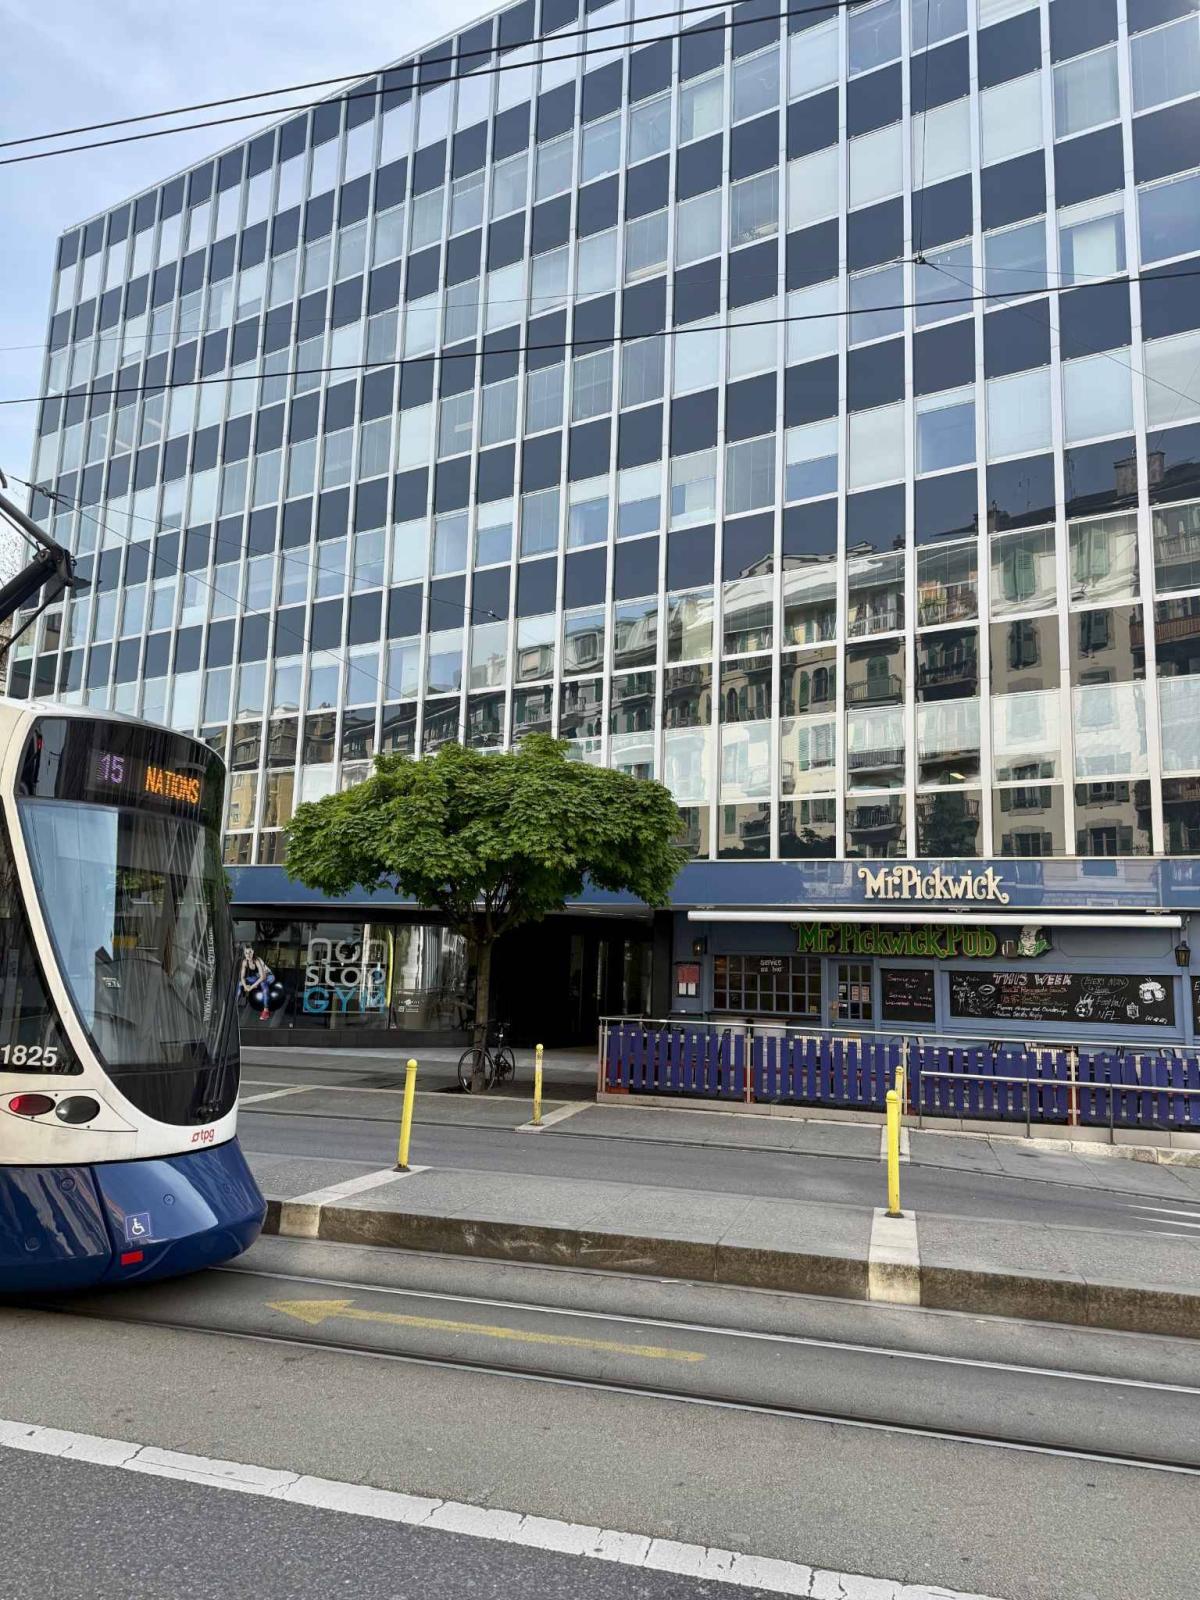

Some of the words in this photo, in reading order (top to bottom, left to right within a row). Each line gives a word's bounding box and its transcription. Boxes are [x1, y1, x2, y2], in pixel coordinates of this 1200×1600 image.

[100, 752, 125, 784] 15
[145, 765, 200, 804] NATIONS
[943, 923, 998, 958] Pub
[304, 962, 387, 987] stop
[992, 973, 1028, 986] THIS
[1034, 974, 1073, 986] WEEK
[0, 1044, 58, 1067] 1825
[201, 1129, 215, 1143] tpg
